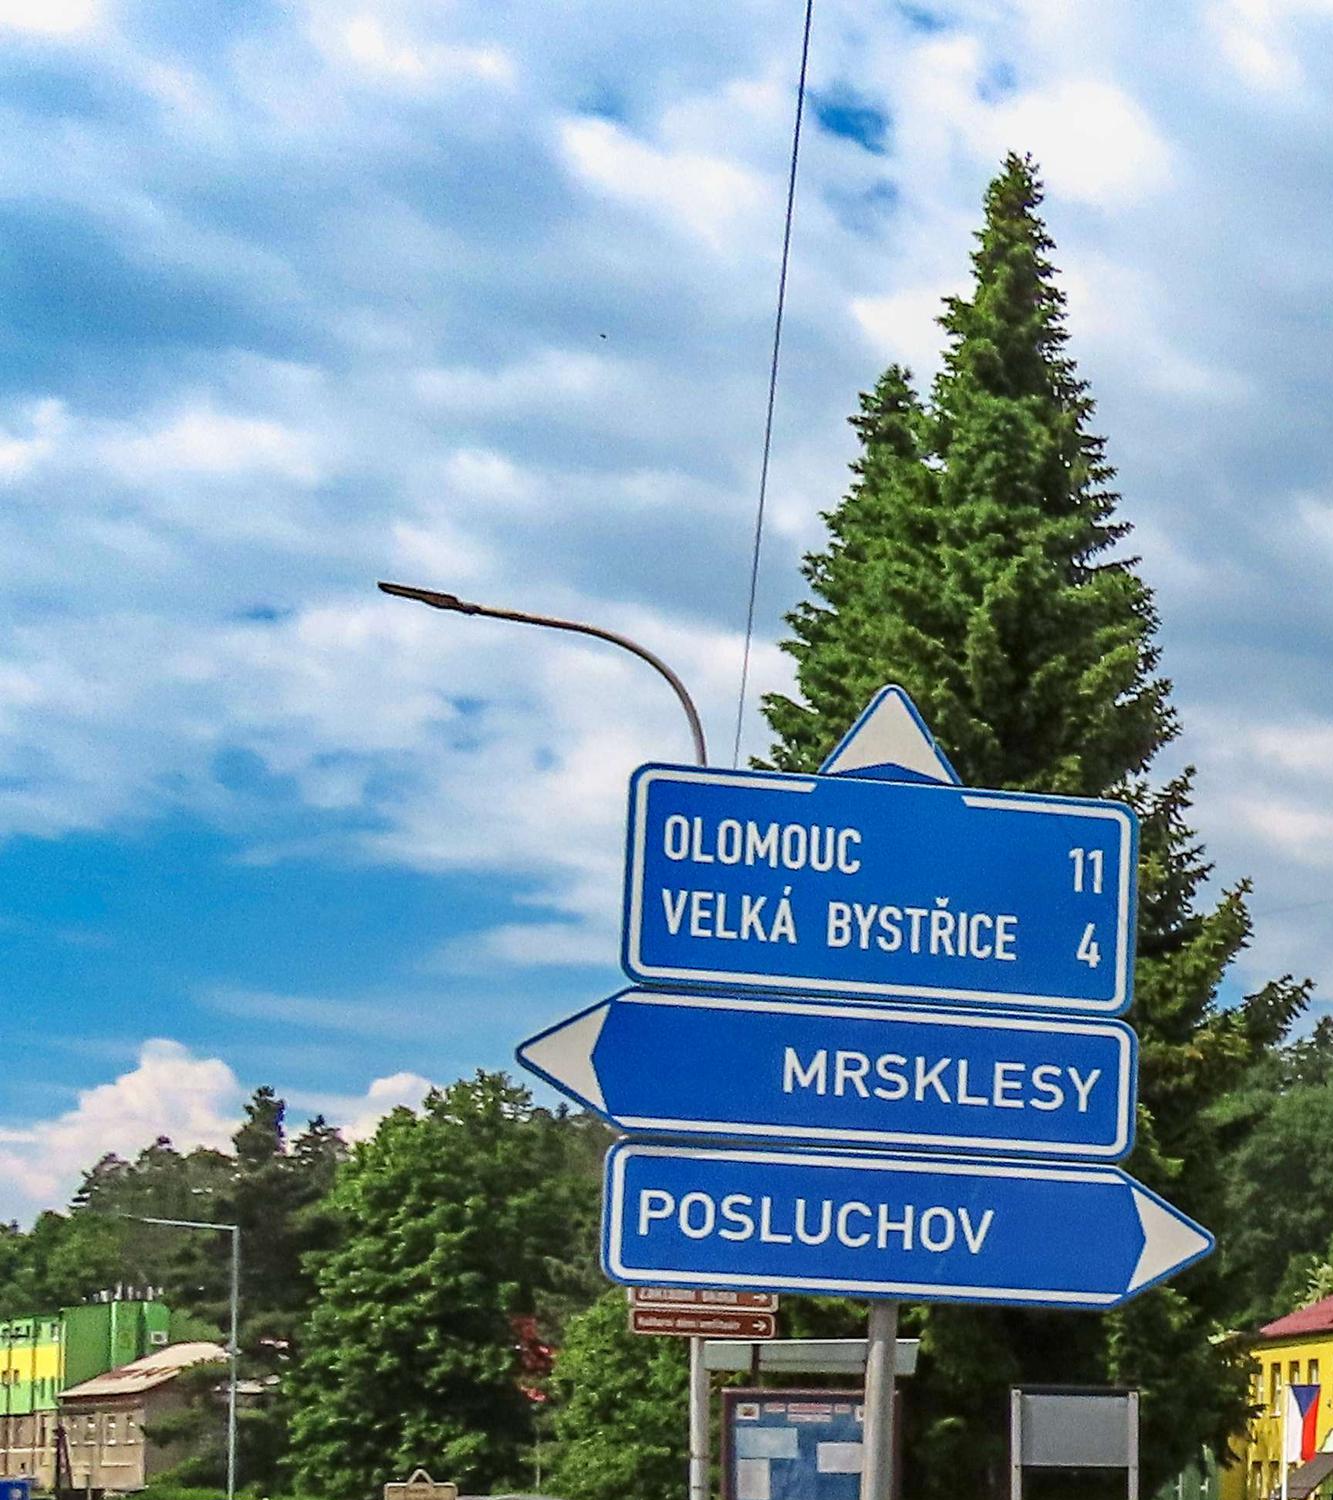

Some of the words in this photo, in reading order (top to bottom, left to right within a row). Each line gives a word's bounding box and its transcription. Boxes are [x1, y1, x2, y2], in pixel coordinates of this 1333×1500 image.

[664, 815, 862, 874] OLOMOUC
[1069, 848, 1103, 894] 11
[662, 885, 797, 944] VELKÁ
[827, 897, 1018, 961] BYSTŘICE
[1076, 922, 1101, 968] 4
[783, 1047, 1101, 1113] MRSKLESY
[639, 1189, 994, 1254] POSLUCHOV
